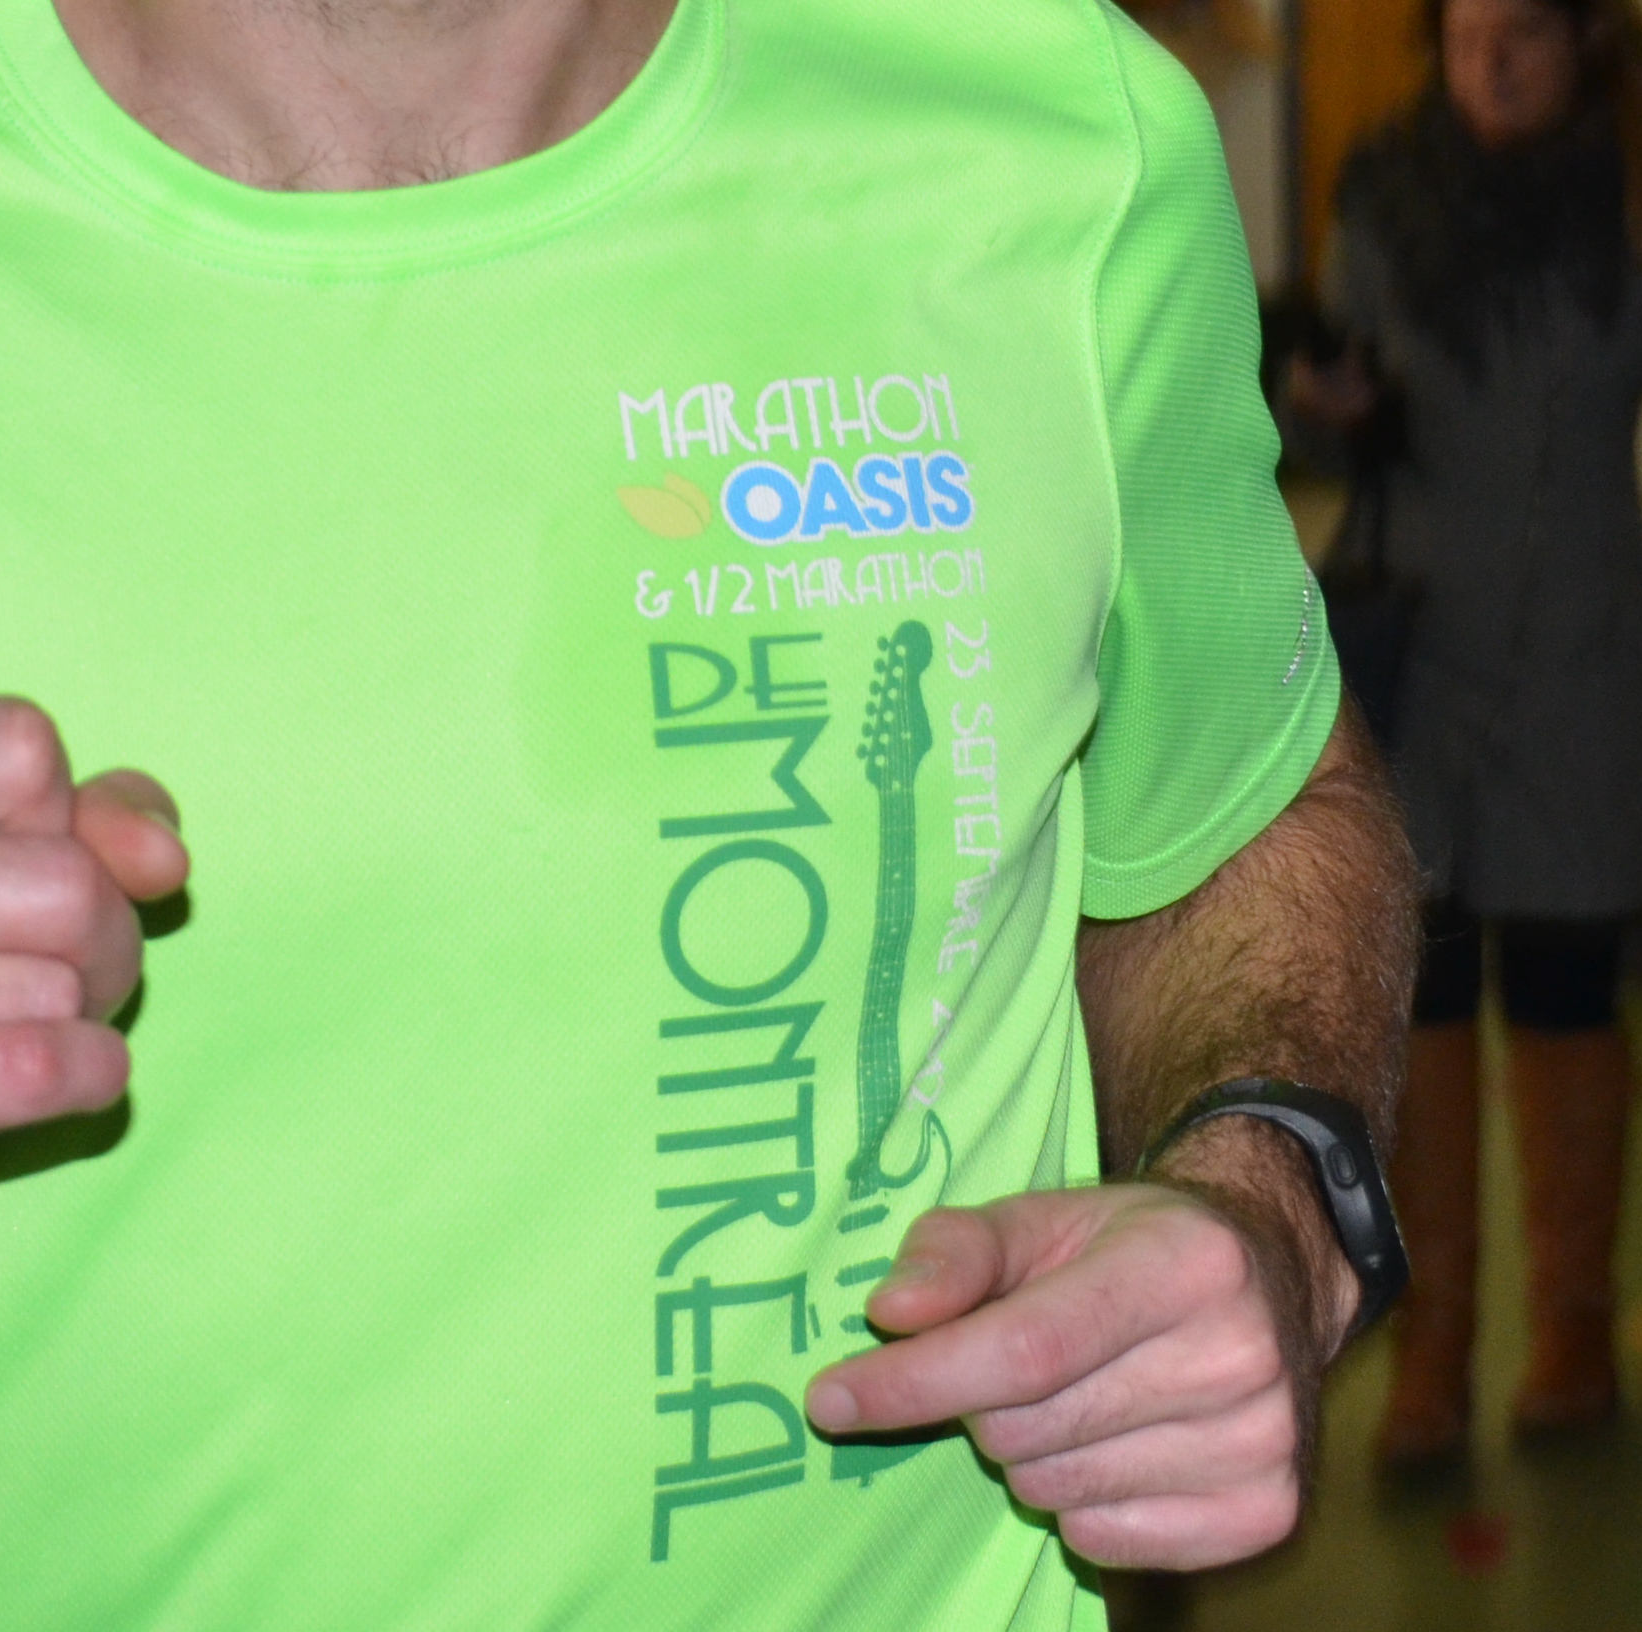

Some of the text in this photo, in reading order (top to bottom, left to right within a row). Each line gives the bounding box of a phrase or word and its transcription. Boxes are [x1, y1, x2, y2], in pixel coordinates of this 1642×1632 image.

[618, 373, 958, 460] MARATHON
[721, 451, 974, 545] OASIS
[635, 547, 986, 618] & 1/2 MARATHON
[648, 633, 827, 719] DE
[945, 620, 991, 679] 23
